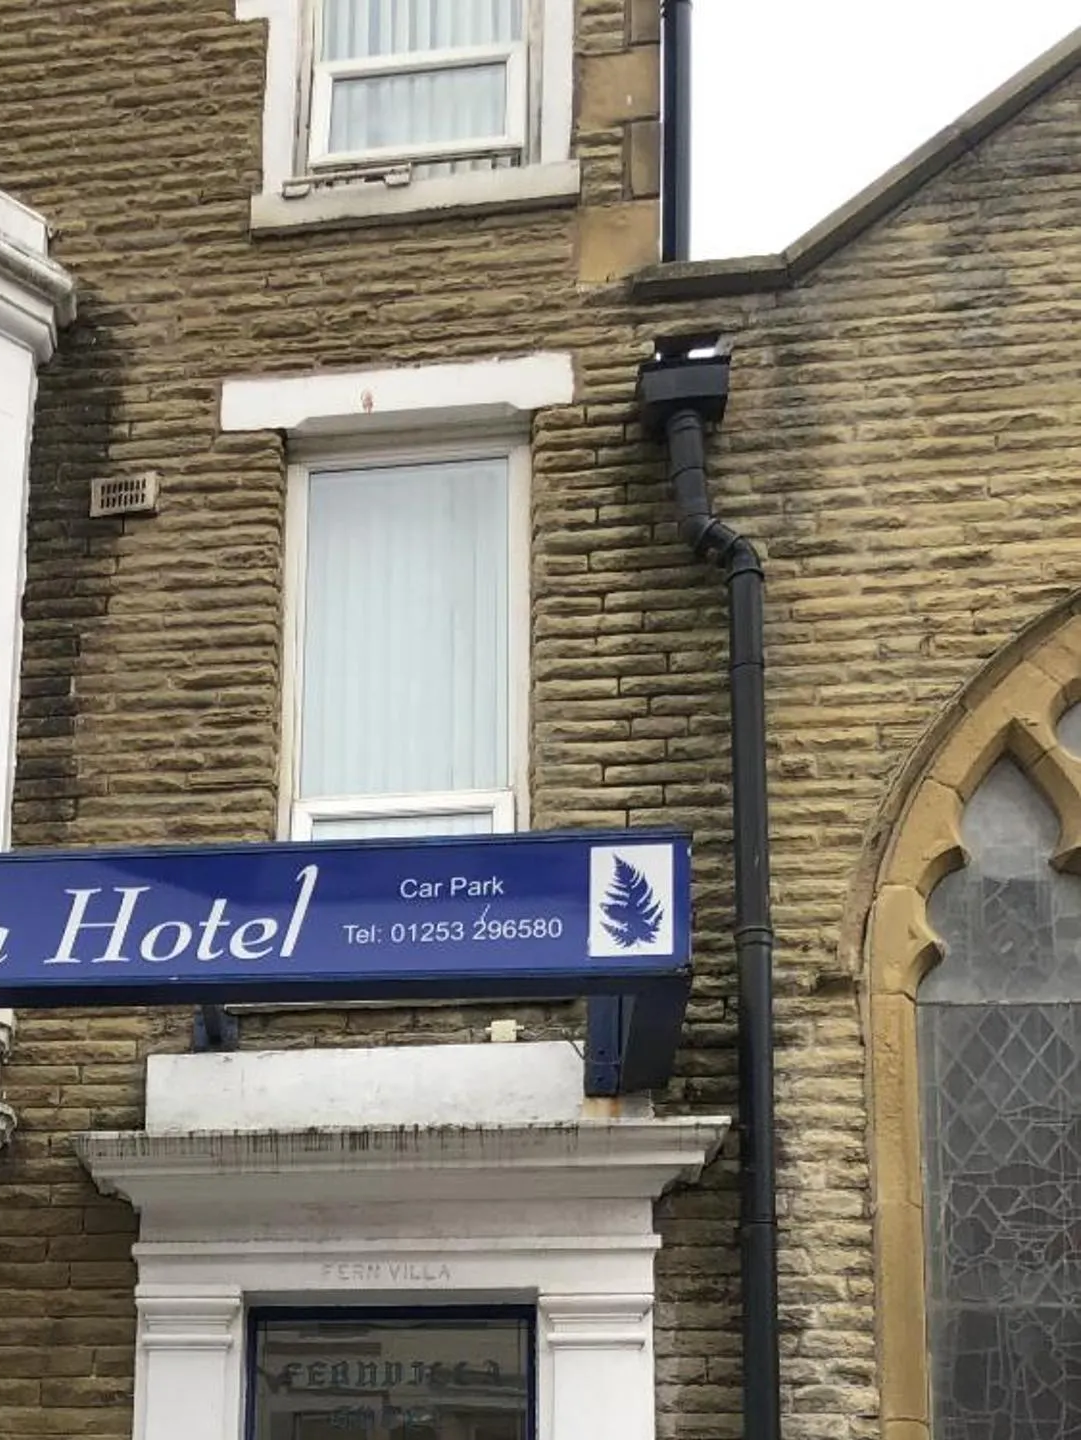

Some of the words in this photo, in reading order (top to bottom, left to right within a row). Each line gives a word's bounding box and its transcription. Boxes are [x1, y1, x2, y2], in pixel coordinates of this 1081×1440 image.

[400, 878, 442, 898] Car
[451, 876, 504, 898] Park
[43, 865, 317, 966] Hotel
[344, 924, 381, 945] Tel:
[391, 922, 463, 943] 01253
[473, 918, 561, 941] 296580
[322, 1264, 381, 1281] FERN
[390, 1263, 451, 1281] VILLA
